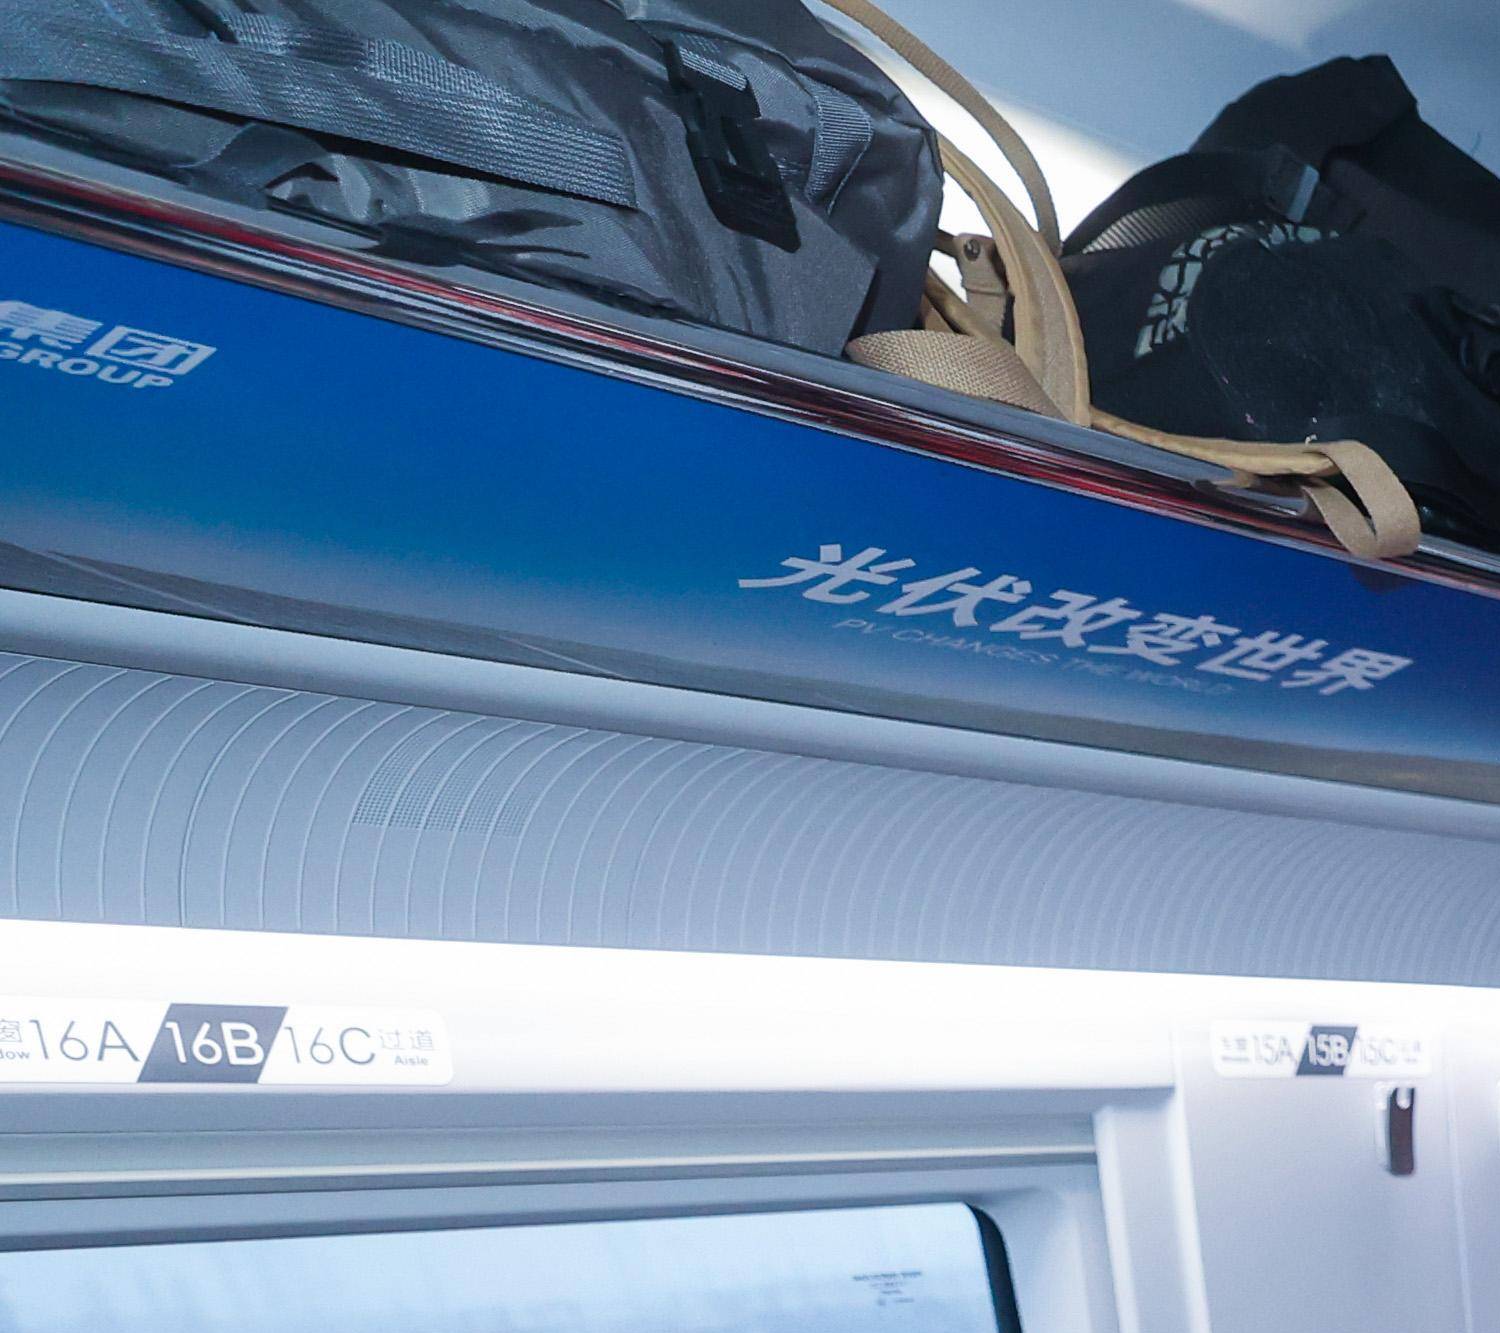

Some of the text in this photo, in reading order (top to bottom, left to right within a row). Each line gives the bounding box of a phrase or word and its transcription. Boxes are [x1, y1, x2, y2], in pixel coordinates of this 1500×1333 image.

[0, 341, 174, 388] GROUP
[739, 544, 1413, 695] 光伏改变世界
[892, 629, 1058, 664] CHANGES
[29, 1019, 375, 1066] 16A 16B 16C
[379, 1028, 437, 1051] 过道
[1308, 1033, 1348, 1067] 15B
[394, 1055, 429, 1066] Aisle
